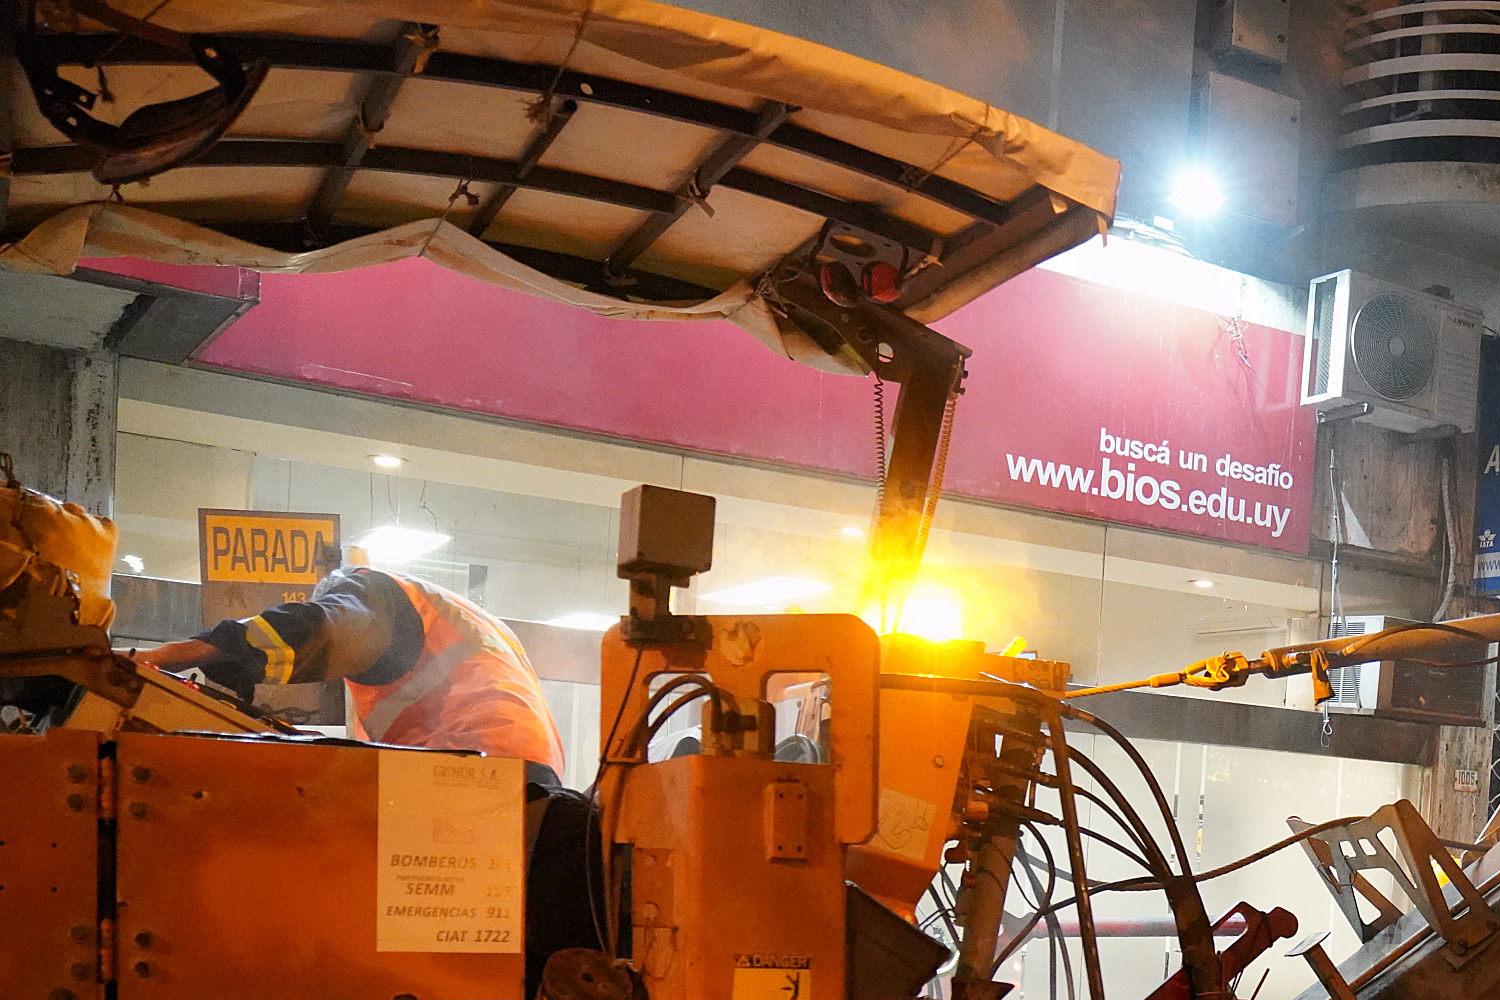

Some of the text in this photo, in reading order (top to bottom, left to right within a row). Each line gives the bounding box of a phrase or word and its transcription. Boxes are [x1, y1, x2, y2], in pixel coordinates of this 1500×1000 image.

[1099, 427, 1293, 490] buscá un desafío
[1006, 453, 1291, 538] www.bios.edu.uy
[212, 526, 326, 574] PARADA
[1458, 771, 1475, 785] 1005
[390, 854, 476, 870] BOMBEROS
[406, 882, 455, 897] SEMM
[386, 906, 476, 919] EMERGENCIAS
[436, 930, 510, 943] CIAT 1722
